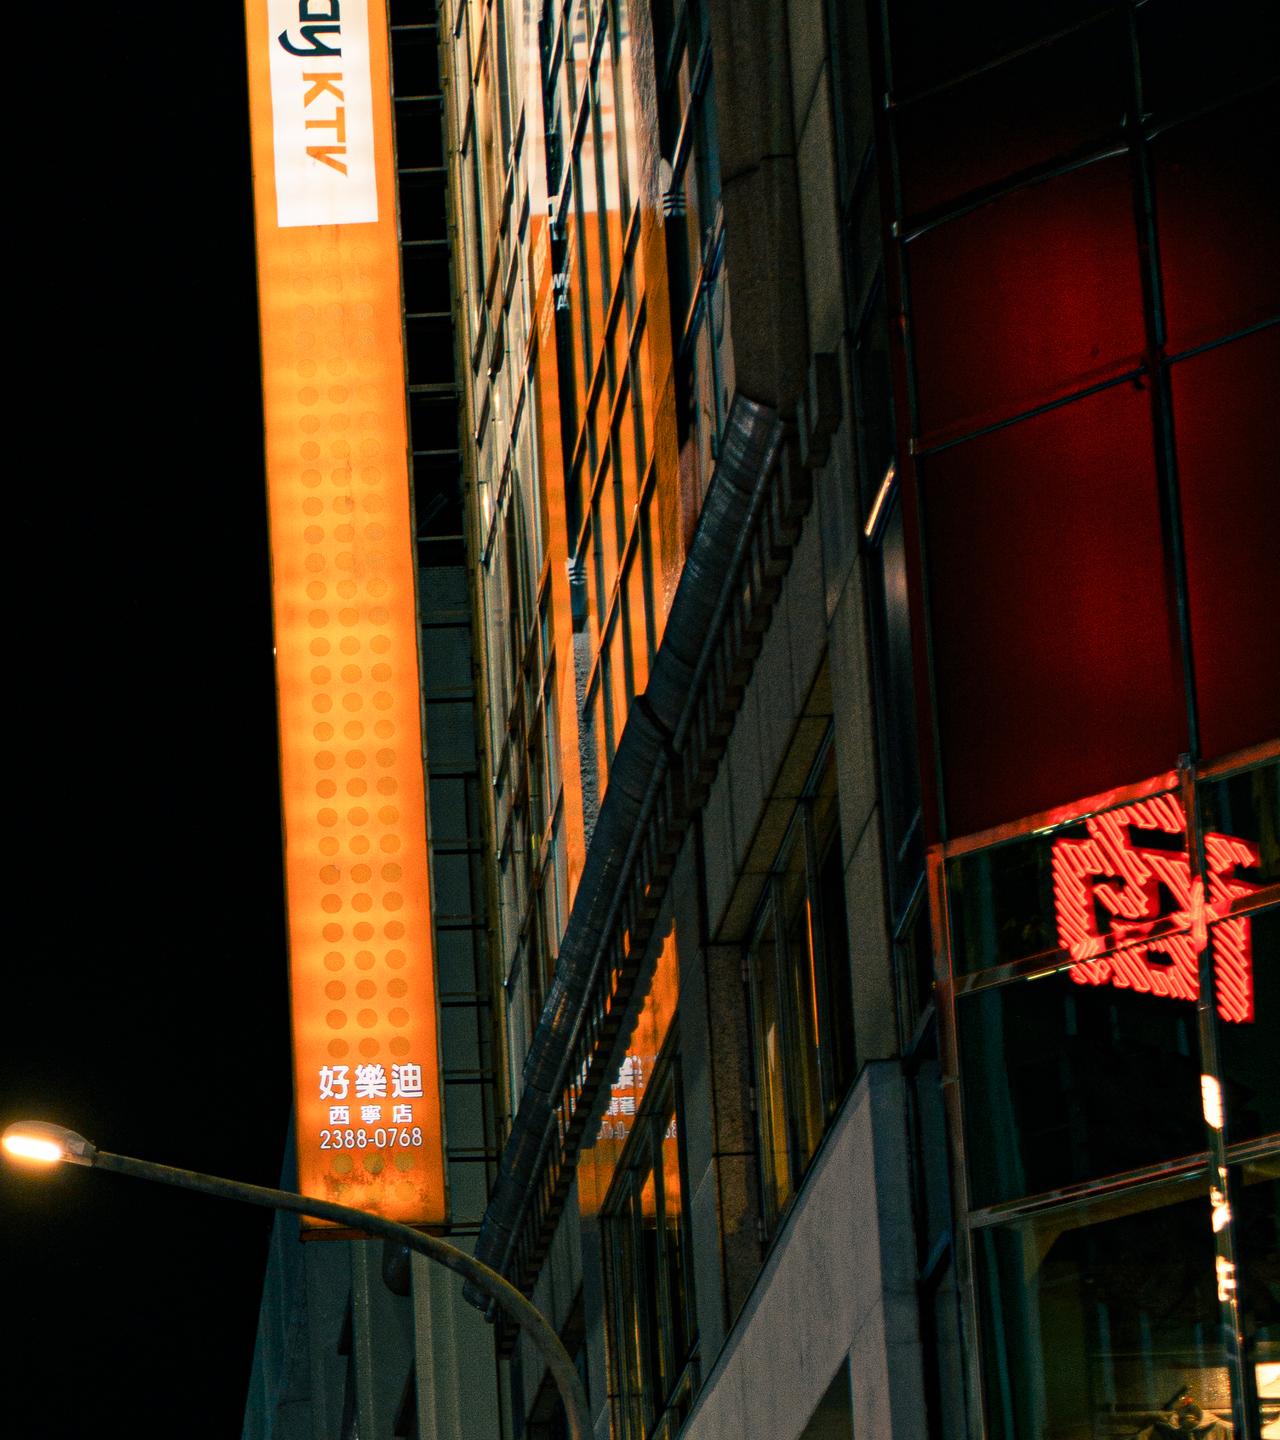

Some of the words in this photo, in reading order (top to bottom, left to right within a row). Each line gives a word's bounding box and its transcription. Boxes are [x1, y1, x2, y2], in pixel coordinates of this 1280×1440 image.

[302, 71, 348, 176] KTV
[319, 1063, 424, 1100] 好樂迪
[329, 1105, 413, 1126] 西寧店
[320, 1128, 423, 1149] 2388-0768
